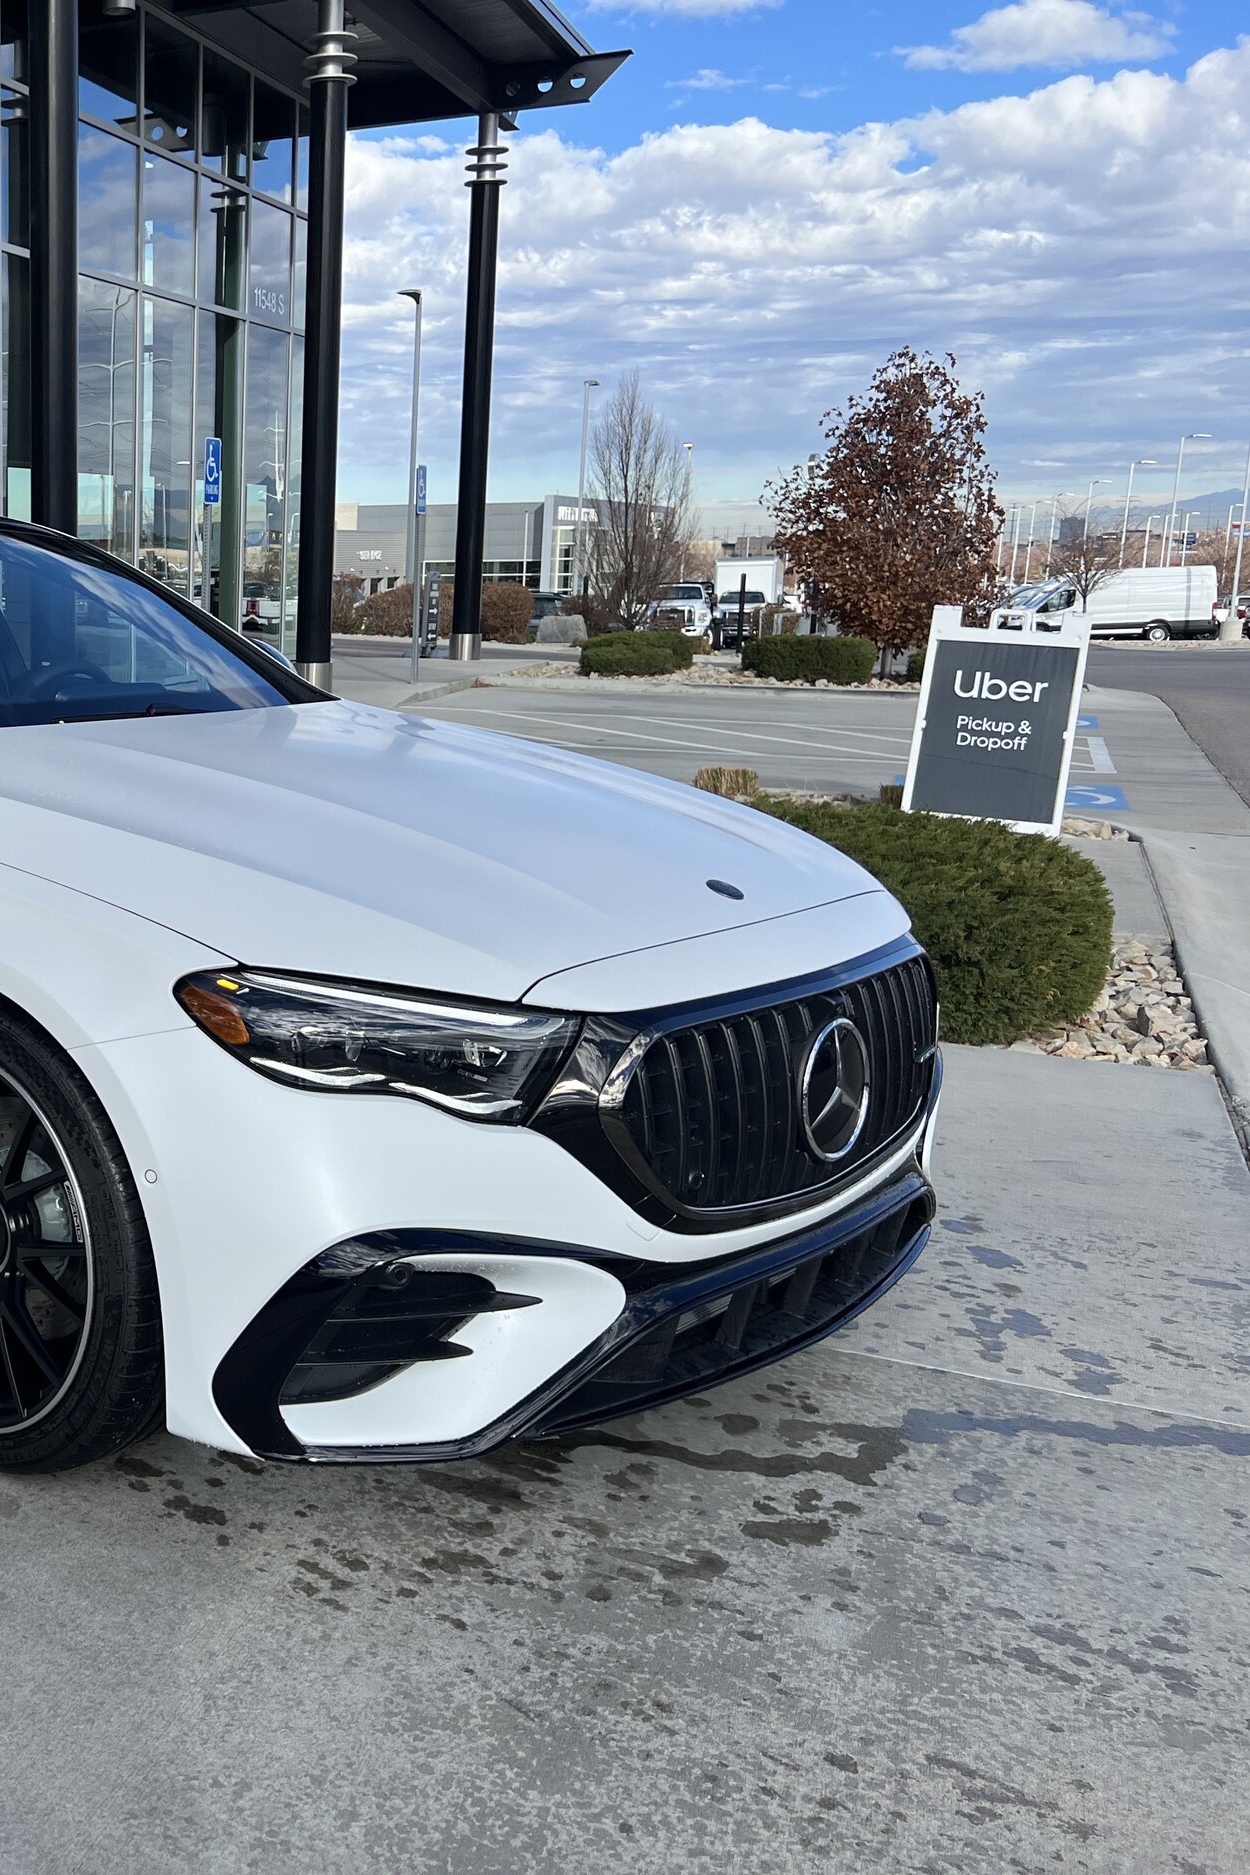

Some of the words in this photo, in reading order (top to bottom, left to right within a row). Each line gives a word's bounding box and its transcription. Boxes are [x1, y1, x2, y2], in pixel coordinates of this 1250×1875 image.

[254, 287, 276, 313] 11548
[278, 294, 285, 315] S
[954, 669, 1049, 703] Uber
[956, 715, 1015, 736] Pickup
[1018, 720, 1032, 735] &
[956, 731, 1028, 751] Dropoff
